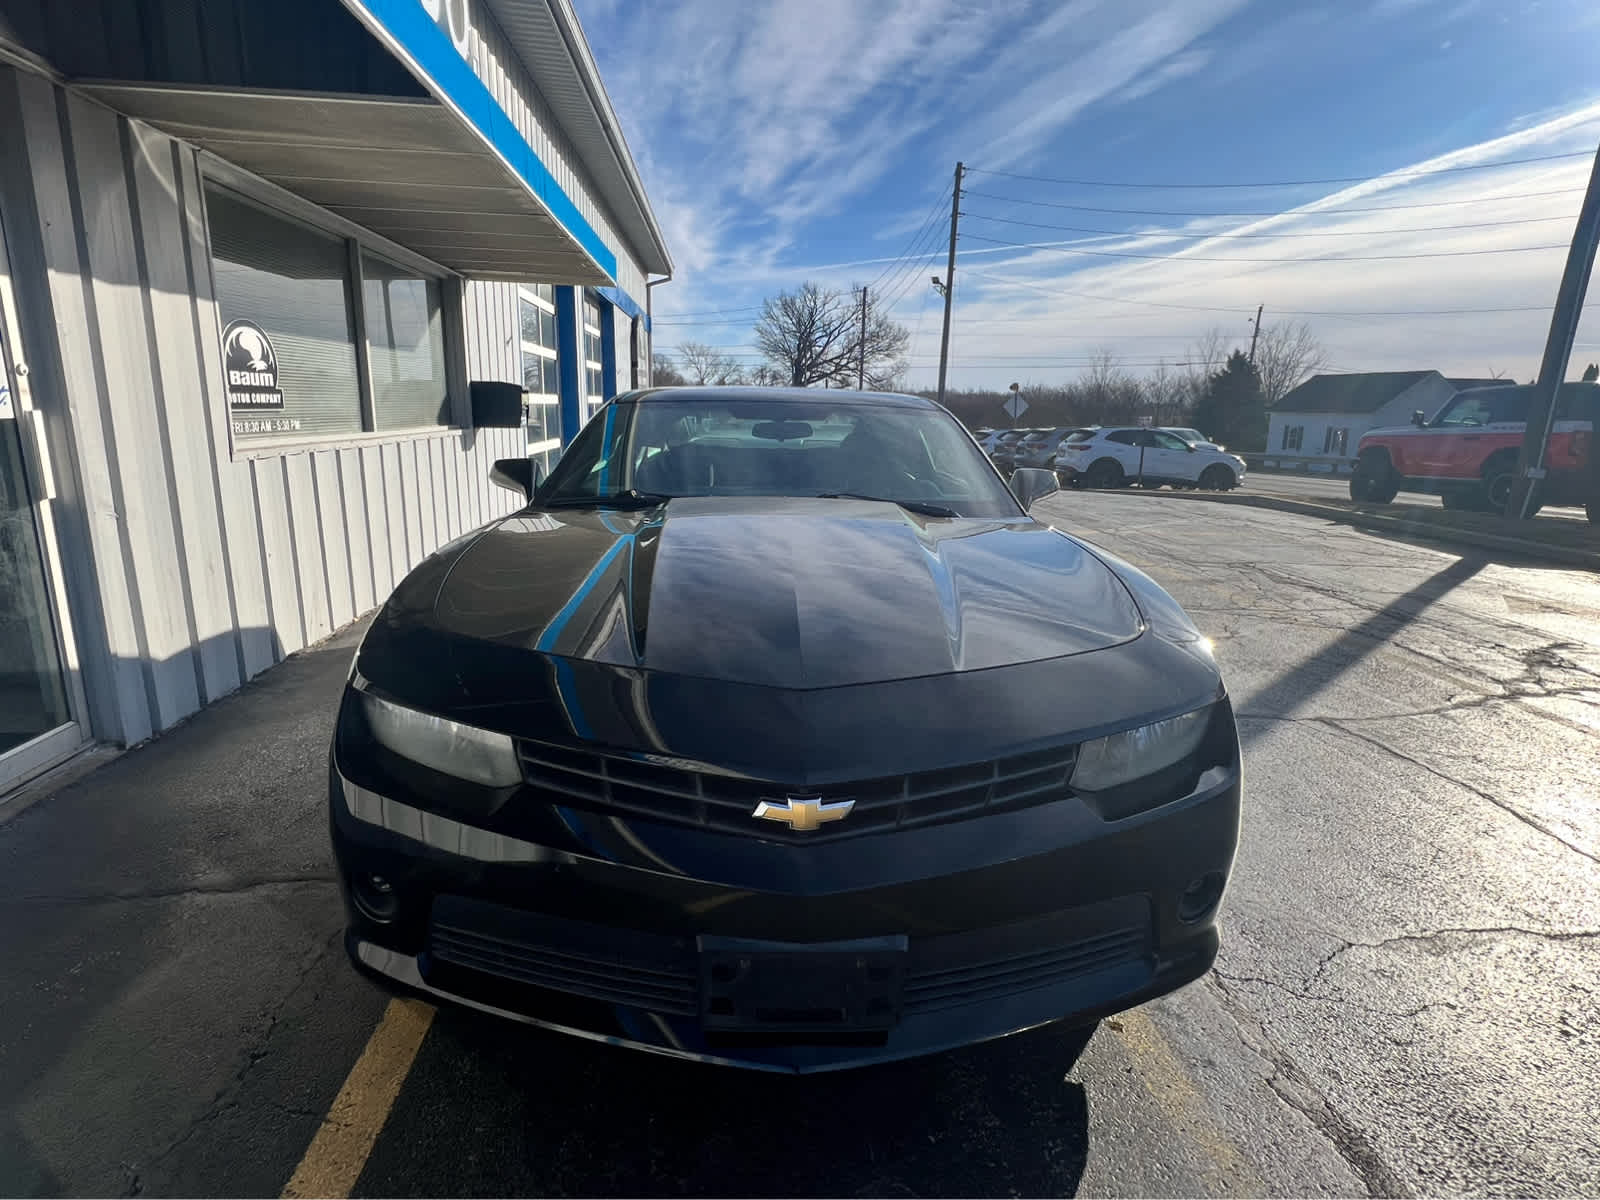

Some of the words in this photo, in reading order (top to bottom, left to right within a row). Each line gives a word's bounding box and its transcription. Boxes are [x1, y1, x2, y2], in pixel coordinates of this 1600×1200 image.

[229, 370, 275, 387] Baum
[231, 392, 251, 404] OTOR
[251, 393, 281, 404] COMPANY
[260, 420, 272, 432] AM
[290, 419, 300, 430] PM
